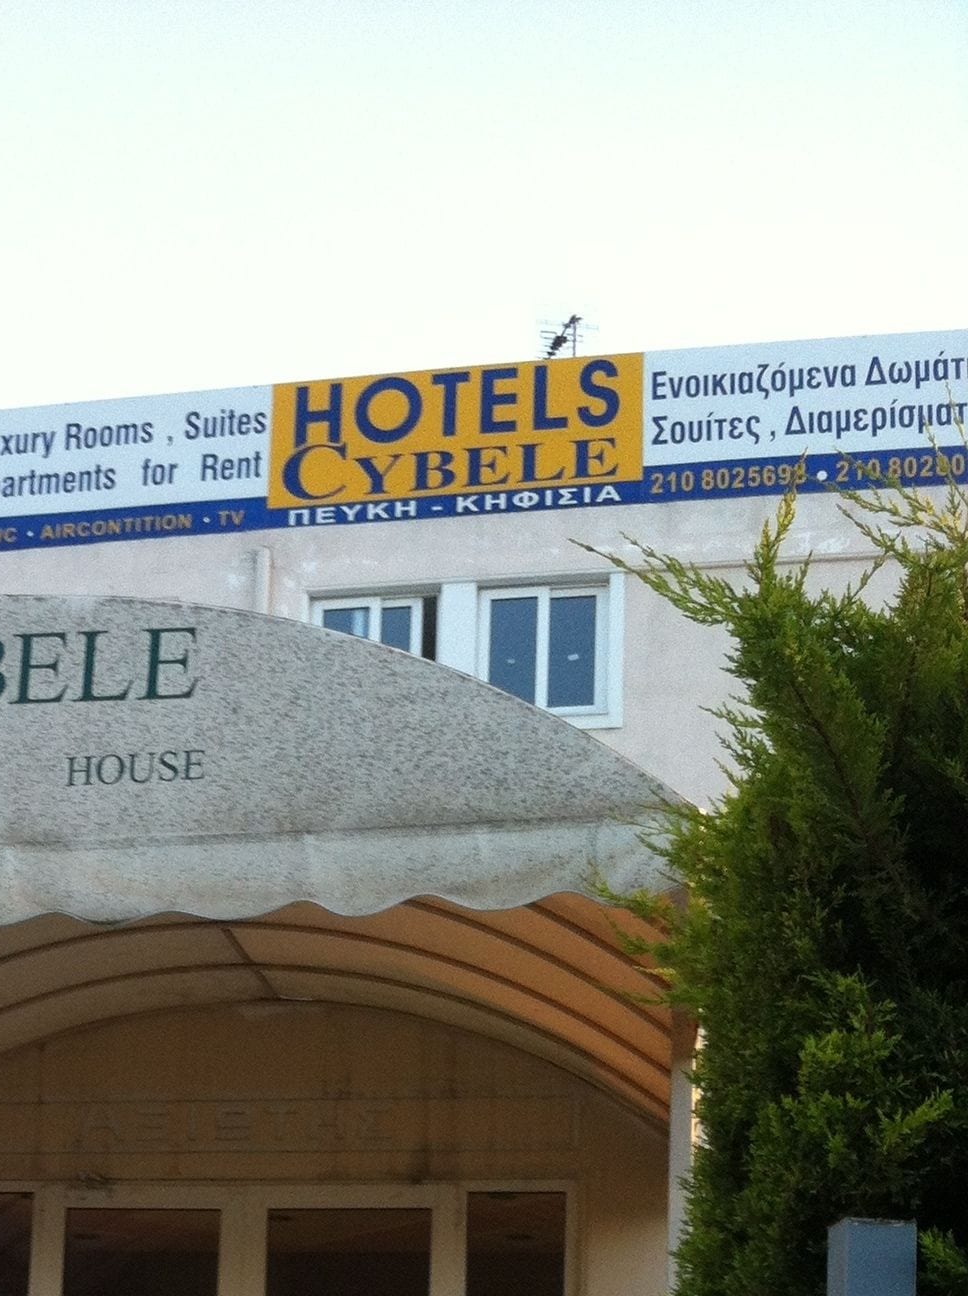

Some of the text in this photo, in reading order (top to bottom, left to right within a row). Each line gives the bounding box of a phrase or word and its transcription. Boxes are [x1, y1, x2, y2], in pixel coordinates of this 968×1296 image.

[651, 351, 968, 400] Ενοικιαζόμενα Δωμάτ
[293, 358, 621, 450] HOTELS
[64, 420, 154, 452] Rooms
[185, 407, 268, 442] Suites
[651, 411, 761, 446] Σουίτες
[140, 457, 179, 487] for
[200, 450, 263, 483] Rent
[281, 436, 619, 501] CYBELE
[650, 470, 694, 495] 210
[39, 512, 193, 542] AIRCONTITION
[217, 509, 246, 526] TV
[287, 498, 418, 527] ΠΕΥΚΗ
[455, 484, 623, 515] ΚΗΦΙΣΙΑ
[65, 748, 207, 788] HOUSE
